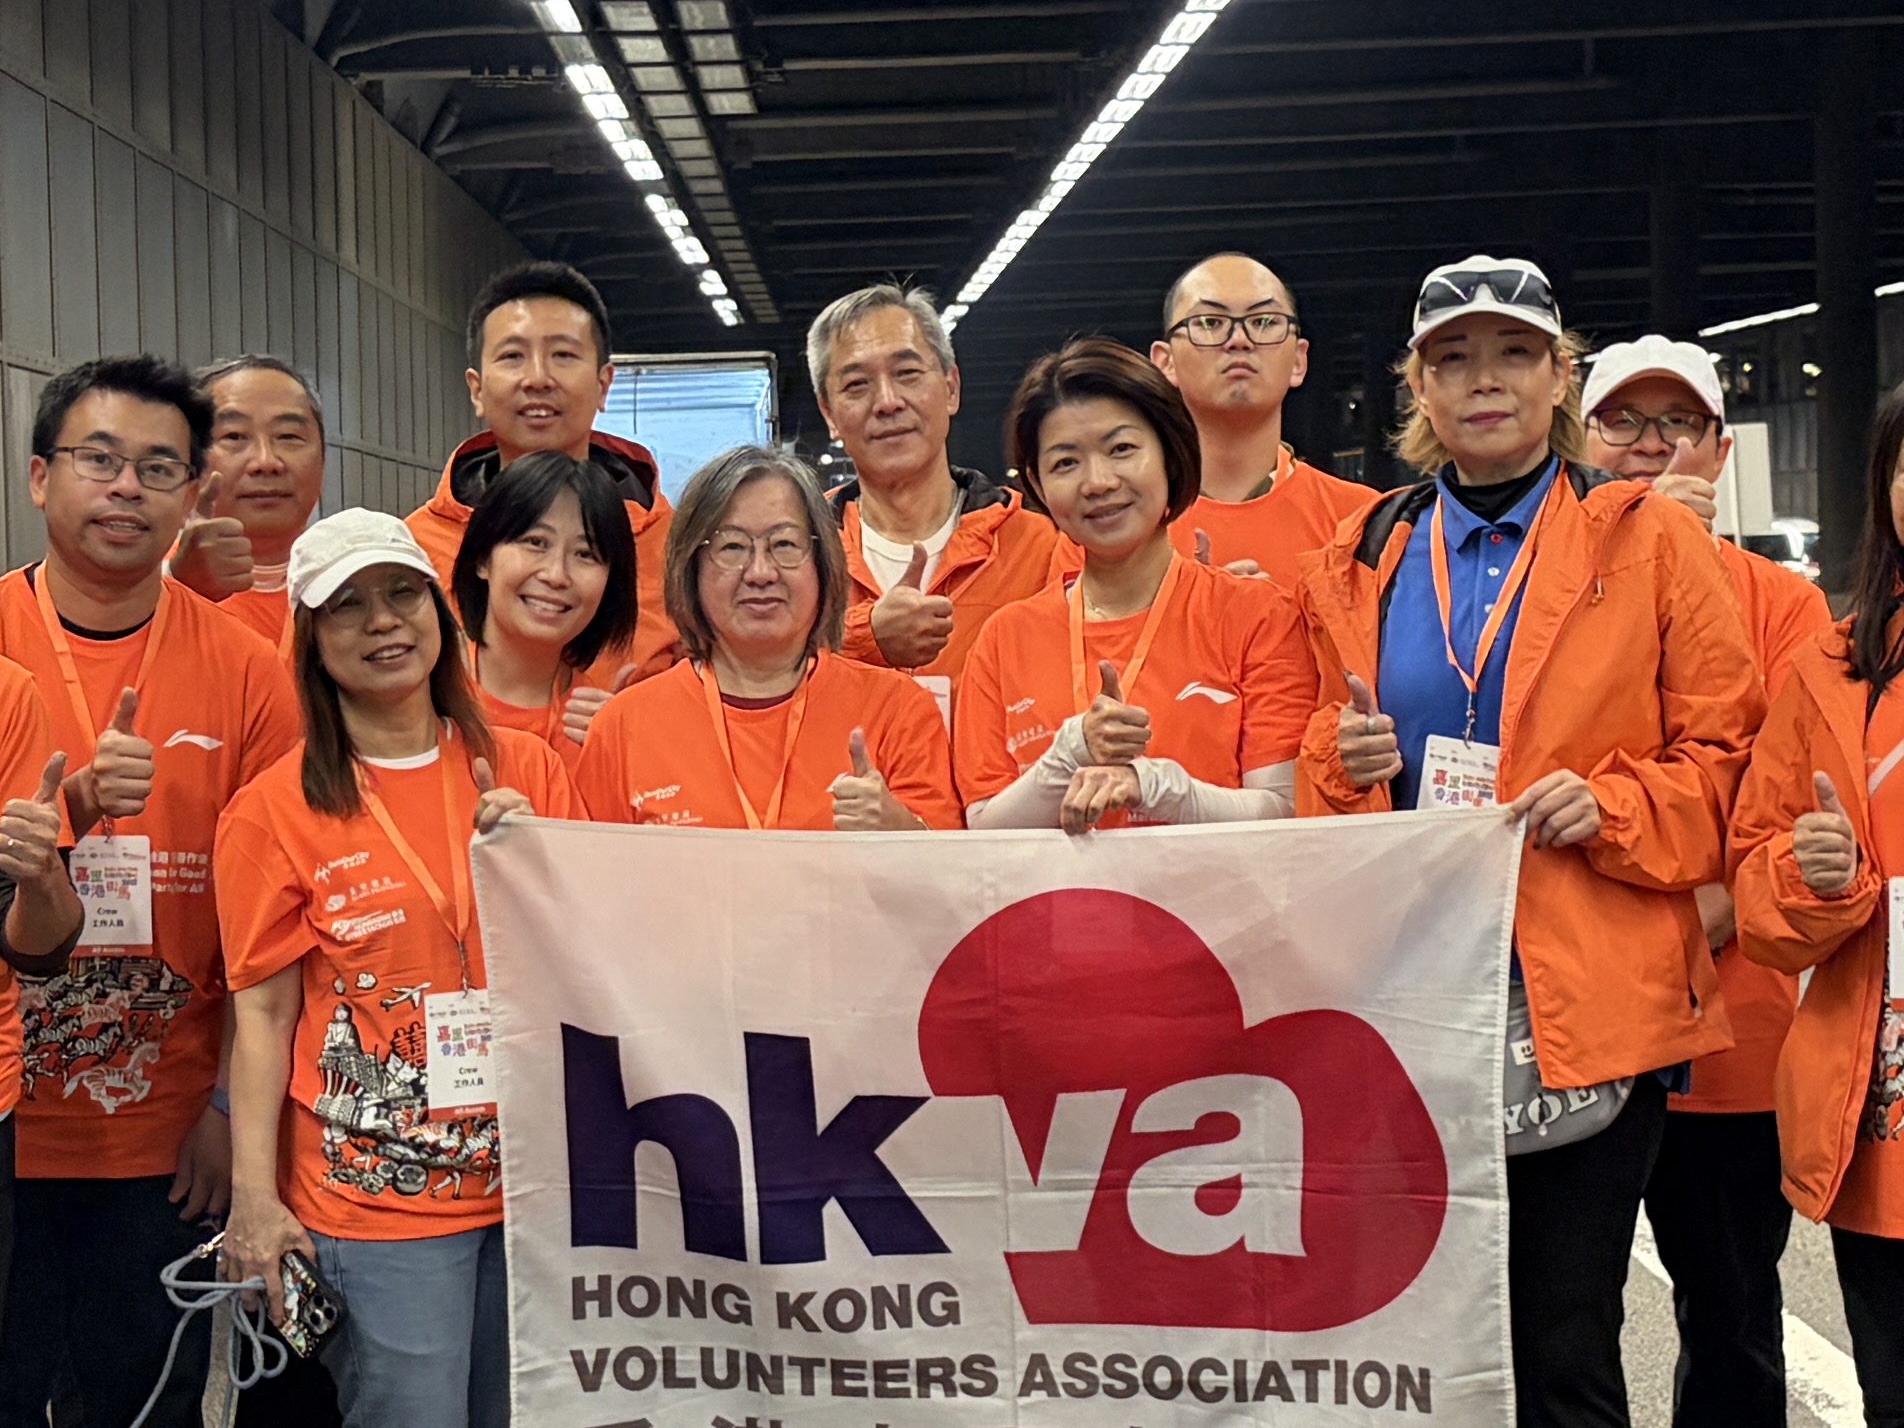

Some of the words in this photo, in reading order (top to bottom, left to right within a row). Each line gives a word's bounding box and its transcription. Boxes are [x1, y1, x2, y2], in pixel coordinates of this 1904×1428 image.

[571, 1274, 752, 1326] HONG
[776, 1281, 962, 1333] KONG
[570, 1346, 999, 1399] VOLUNTEERS
[1018, 1352, 1432, 1414] ASSOCIATION
